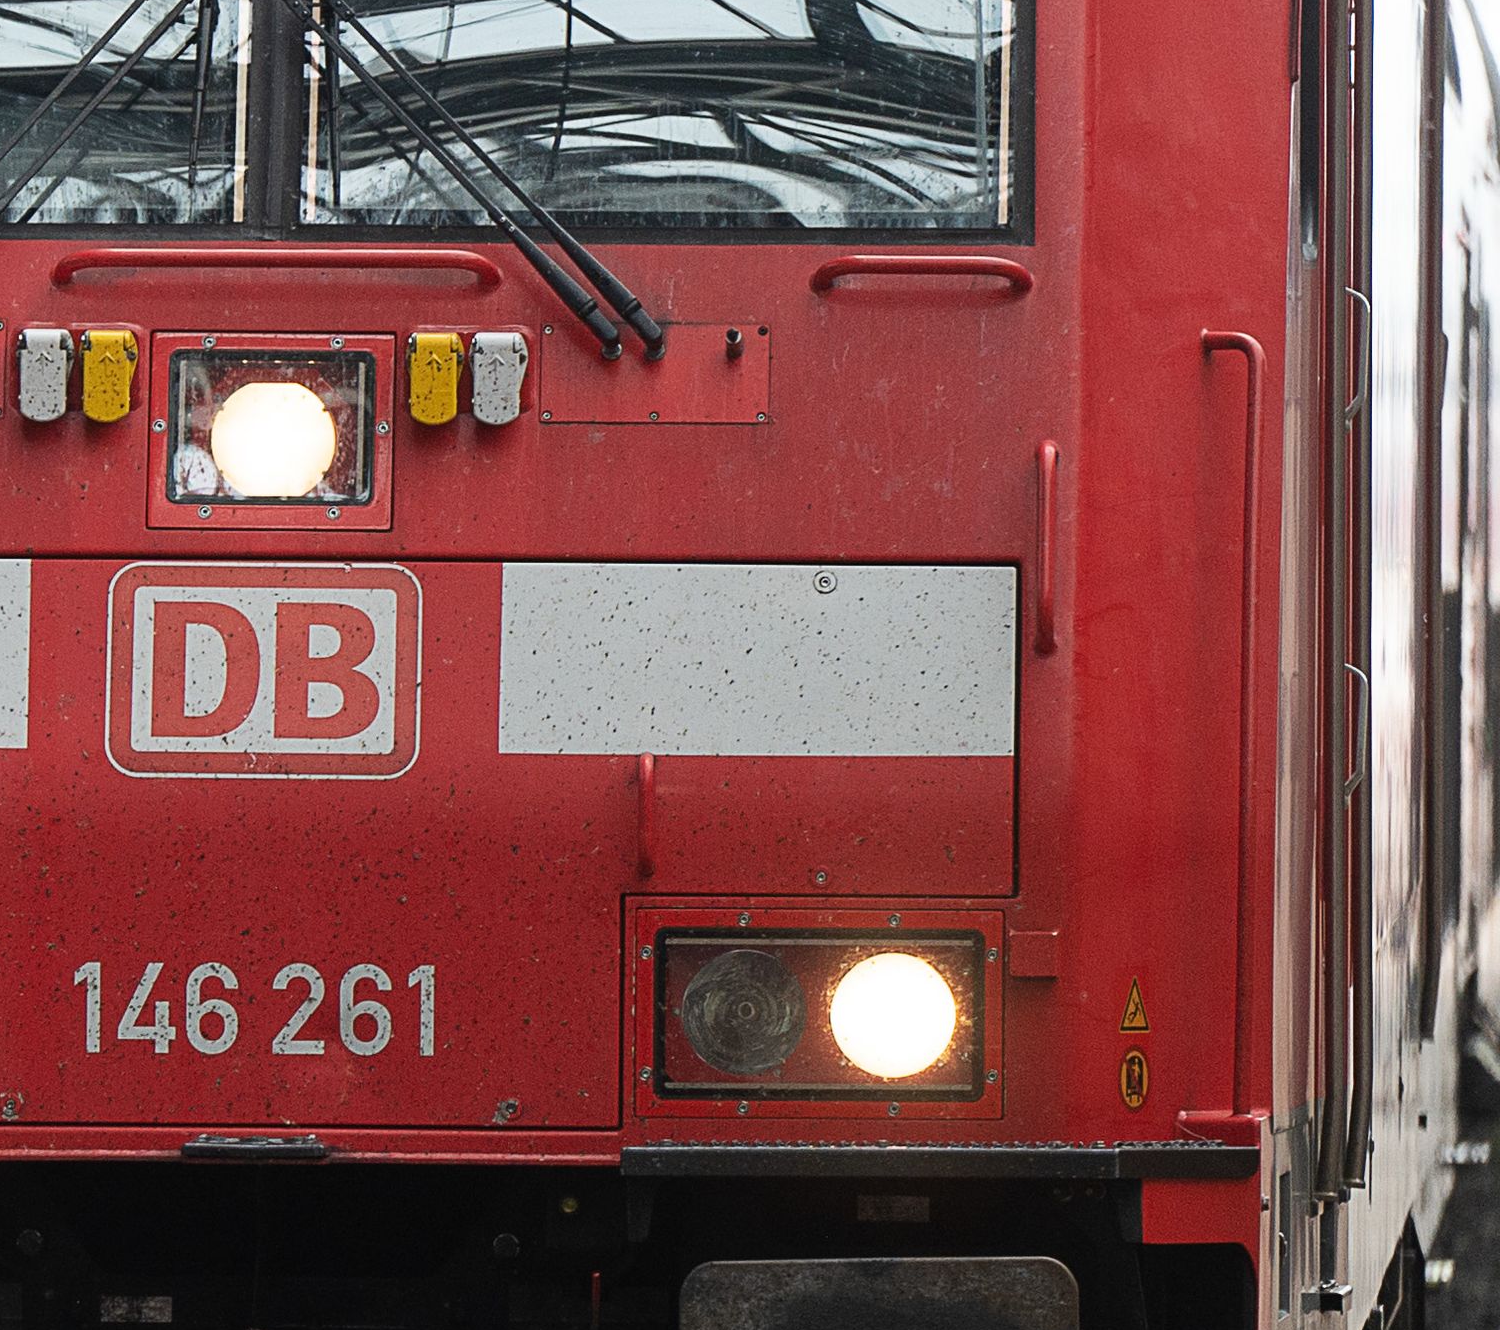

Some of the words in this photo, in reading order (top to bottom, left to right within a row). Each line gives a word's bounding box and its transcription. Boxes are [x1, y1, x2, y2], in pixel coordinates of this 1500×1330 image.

[151, 601, 380, 739] DB
[74, 961, 238, 1056] 146
[271, 962, 436, 1057] 261
